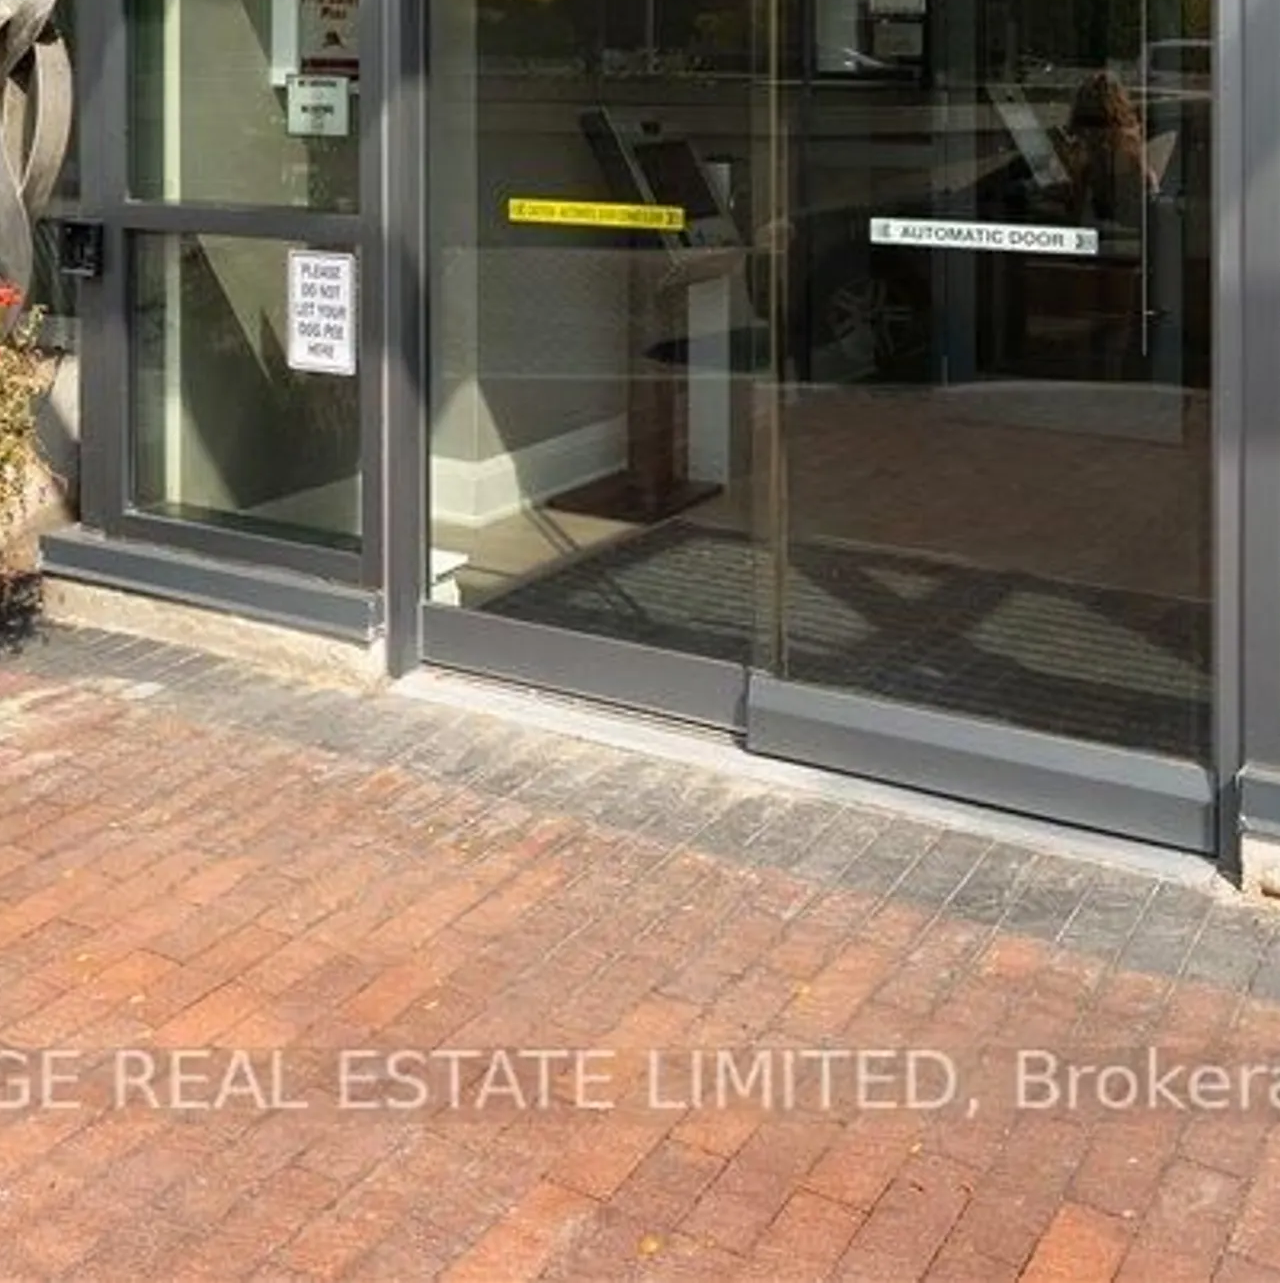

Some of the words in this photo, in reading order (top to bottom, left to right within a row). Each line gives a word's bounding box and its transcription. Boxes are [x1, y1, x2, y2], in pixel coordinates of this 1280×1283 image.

[899, 225, 1004, 245] AUTOMATIC
[1007, 230, 1065, 248] DOOR
[301, 262, 341, 280] PLEASE
